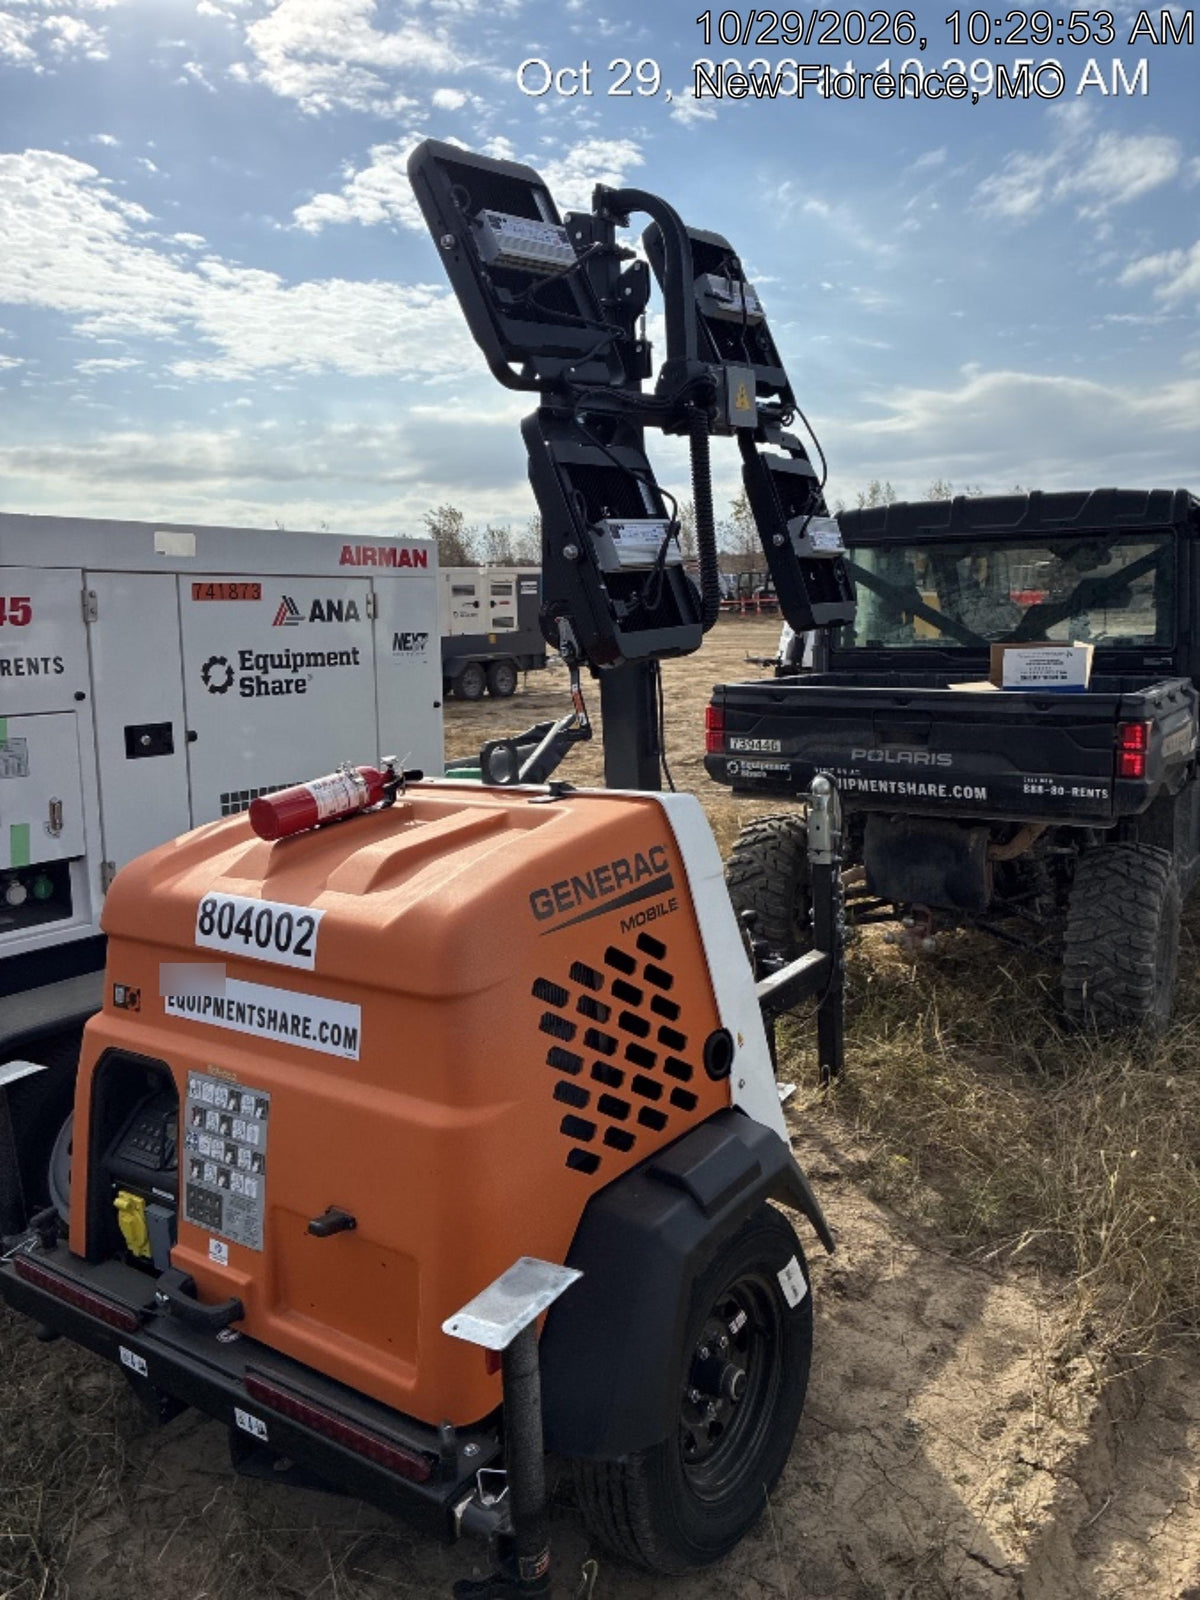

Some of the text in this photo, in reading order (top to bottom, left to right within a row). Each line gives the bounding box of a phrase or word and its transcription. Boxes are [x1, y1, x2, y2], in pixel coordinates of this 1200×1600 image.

[339, 545, 428, 569] AIRMAN
[192, 583, 262, 600] 741873
[309, 599, 361, 623] ANA
[238, 646, 360, 674] Equipment
[239, 674, 307, 697] Share
[851, 748, 953, 767] POLARIS
[529, 846, 669, 922] GENERAC
[199, 898, 315, 957] 804002
[620, 897, 680, 934] MOBILE
[168, 995, 357, 1051] EQUIPMENTSHARE.COM
